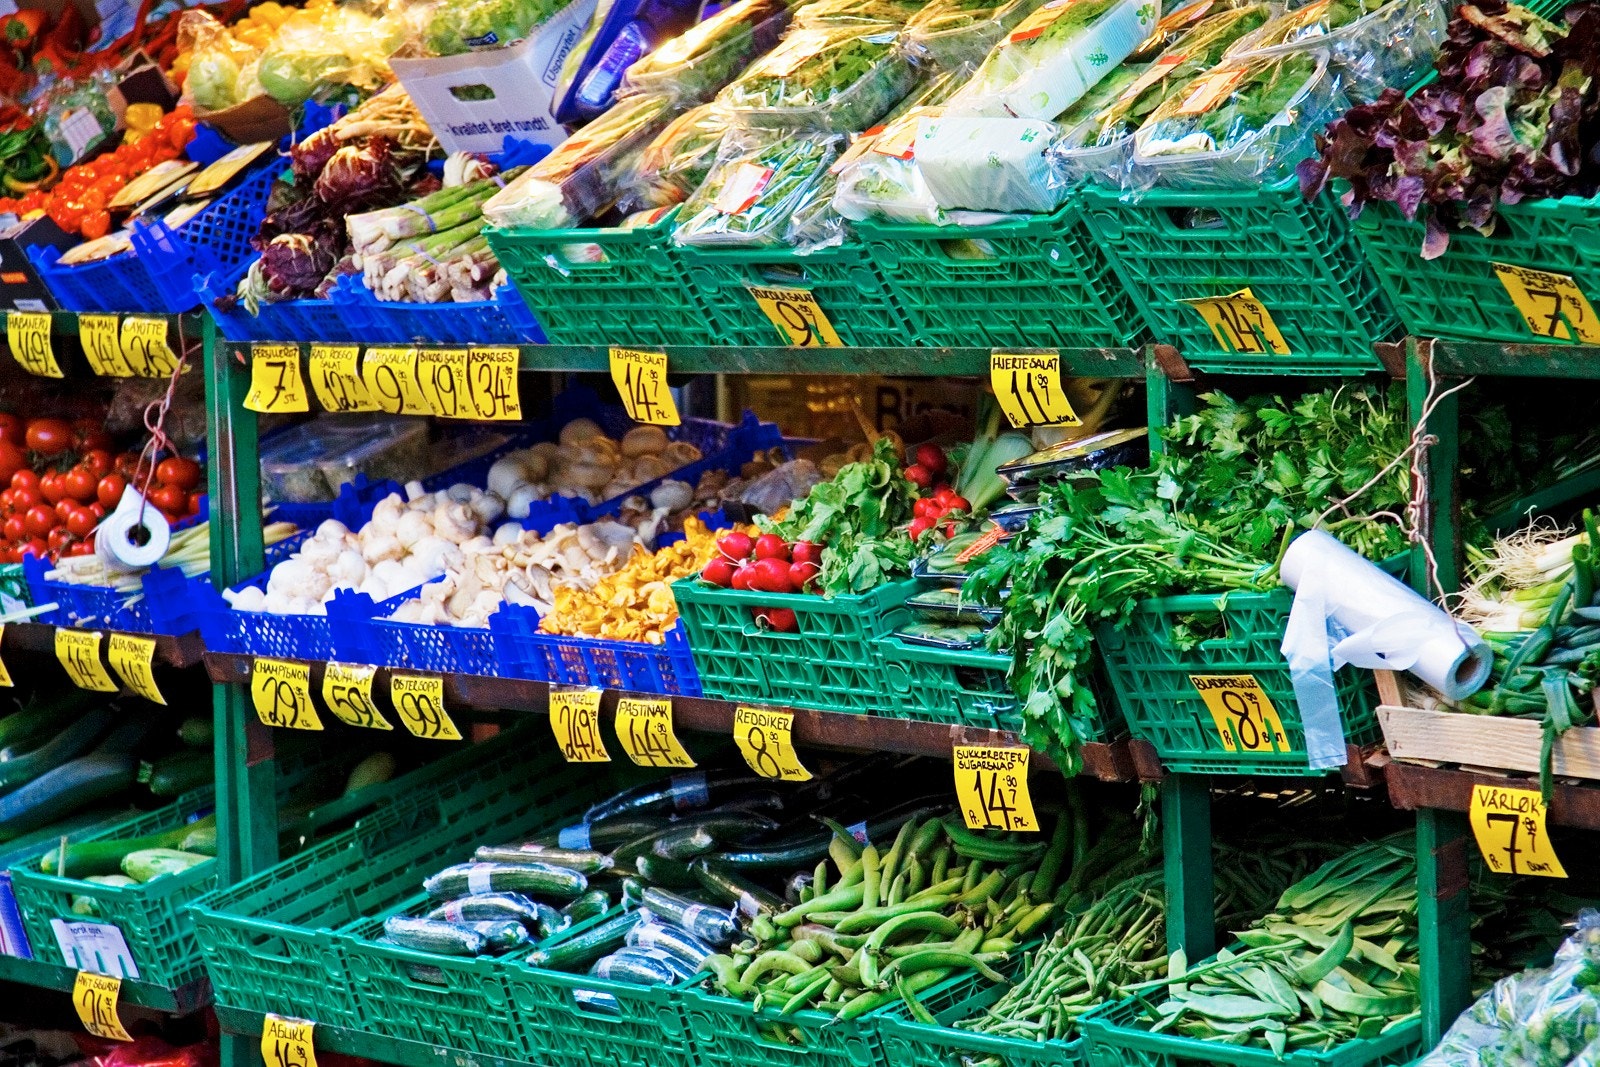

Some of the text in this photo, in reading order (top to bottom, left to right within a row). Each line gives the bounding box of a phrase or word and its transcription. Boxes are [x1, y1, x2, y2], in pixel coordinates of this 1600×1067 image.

[449, 116, 550, 136] kvalitet året rundt!
[776, 301, 812, 346] 9
[1213, 302, 1265, 352] 14
[1525, 288, 1562, 336] 7
[18, 331, 49, 374] 149
[472, 352, 515, 364] ASPARGES
[992, 357, 1058, 372] HJERTESALAT
[266, 361, 287, 410] 7
[376, 365, 403, 414] 9
[432, 365, 457, 416] 19
[478, 363, 510, 418] 34
[625, 363, 658, 421] 14
[1010, 371, 1053, 427] 11
[262, 676, 299, 727] 29
[332, 685, 374, 728] 59
[1192, 677, 1258, 691] BLADPERSILLE
[401, 692, 442, 737] 99
[559, 705, 595, 761] 249
[618, 700, 670, 720] PASTINAK
[736, 709, 791, 732] REDDIKER
[1221, 690, 1260, 749] 8
[629, 718, 674, 767] 44
[748, 726, 782, 779] 8
[958, 760, 1015, 771] SUGARSNAP
[973, 770, 1017, 831] 14
[1478, 789, 1541, 816] VÅRLØK
[1486, 812, 1522, 874] 7
[268, 1021, 309, 1044] AGURK
